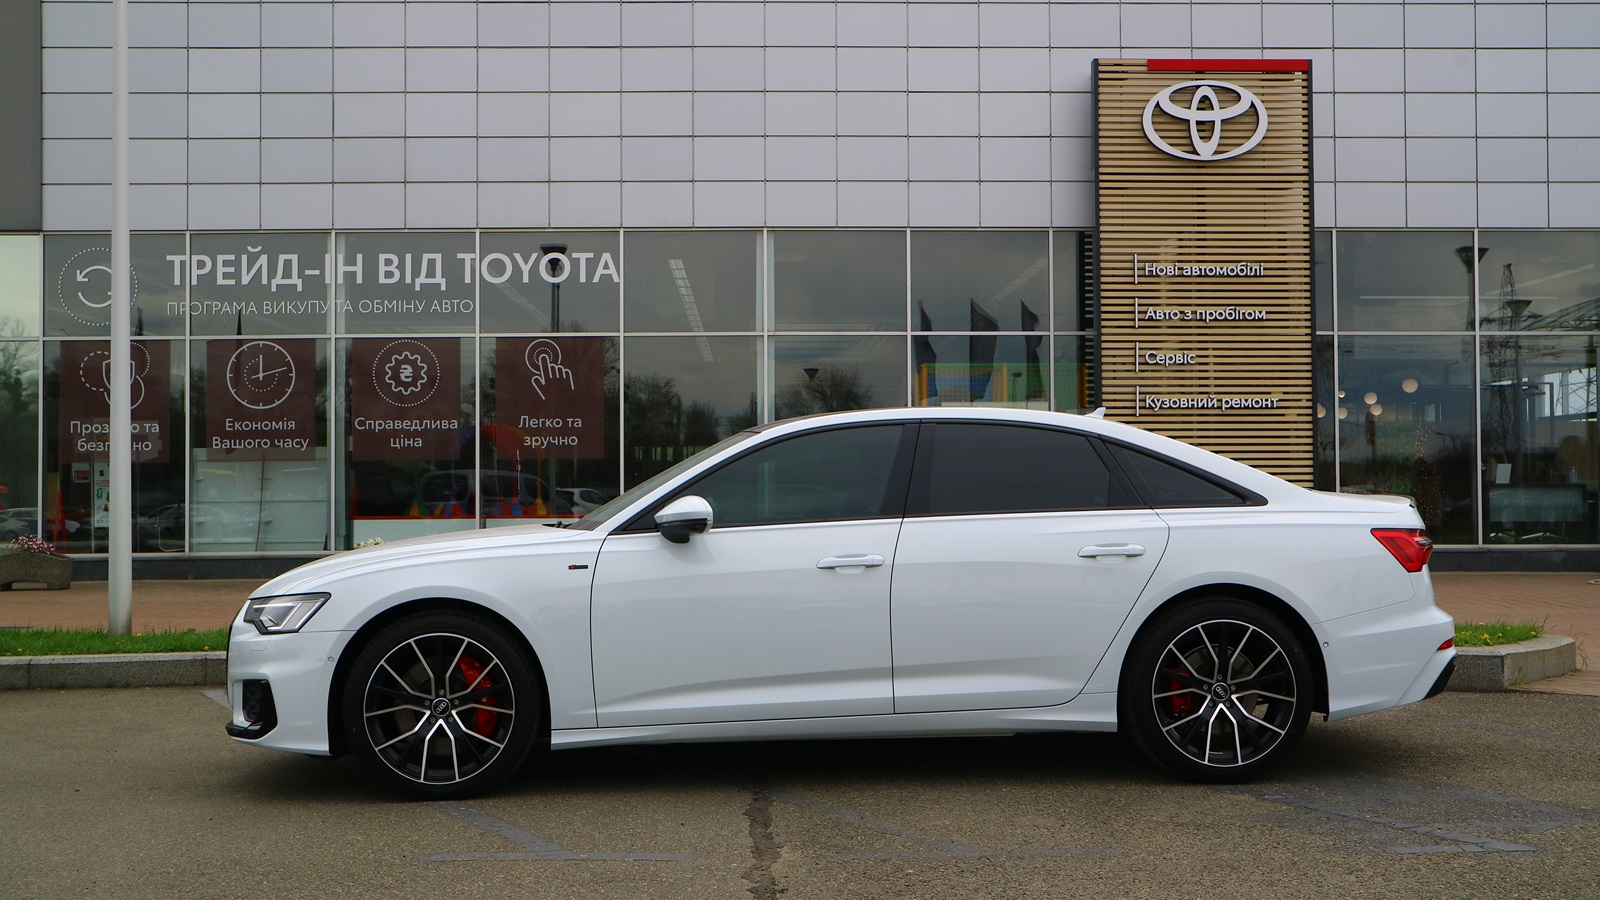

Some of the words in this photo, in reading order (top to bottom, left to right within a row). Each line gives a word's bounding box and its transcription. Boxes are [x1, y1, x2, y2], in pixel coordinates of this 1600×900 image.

[165, 245, 363, 292] ТРЕЙД-ІН
[378, 253, 447, 291] ВІД
[456, 252, 621, 284] TOYOTA
[1145, 262, 1178, 276] Нові
[1182, 262, 1265, 276] автомобілі
[167, 301, 258, 316] ПРОГРАМА
[263, 300, 331, 315] ВИКУПУ
[334, 300, 354, 314] ТА
[358, 299, 426, 314] ОБМІНУ
[430, 299, 474, 313] АВТО
[1145, 306, 1181, 320] Авто
[1183, 310, 1193, 320] з
[1196, 306, 1266, 323] пробігом
[1145, 351, 1196, 367] Сервіс
[1145, 394, 1218, 411] Кузовний
[1222, 397, 1279, 411] ремонт
[70, 421, 140, 437] Прозо
[143, 423, 160, 433] та
[225, 417, 296, 431] Економія
[354, 417, 458, 433] Справедлива
[518, 415, 563, 428] Легко
[566, 418, 582, 428] та
[212, 436, 271, 449] Вашого
[274, 438, 309, 451] часу
[390, 434, 423, 449] ціна
[523, 436, 579, 449] зручно
